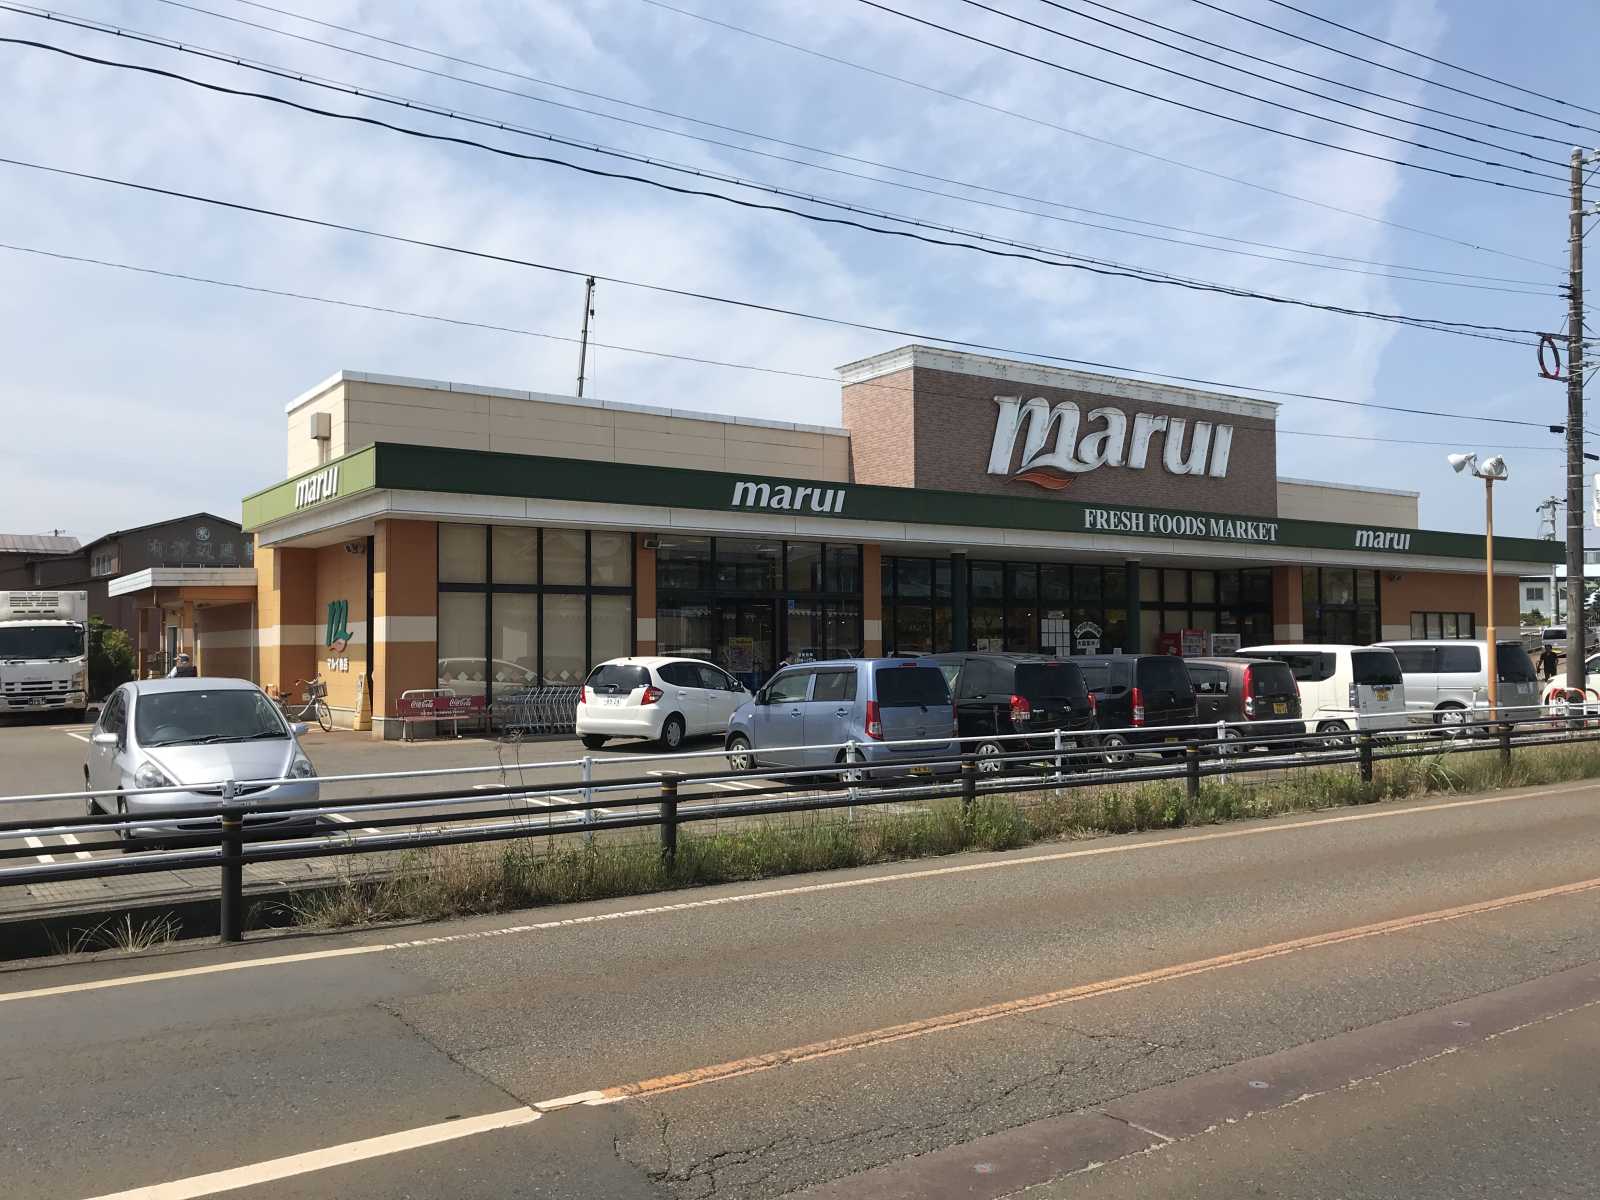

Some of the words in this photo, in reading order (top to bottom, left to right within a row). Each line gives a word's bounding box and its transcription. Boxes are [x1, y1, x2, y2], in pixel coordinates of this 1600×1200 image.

[987, 395, 1234, 478] marui
[295, 465, 338, 508] marui
[731, 481, 846, 513] marui
[1084, 508, 1145, 532] FRESH
[1149, 513, 1206, 537] FOODS
[1209, 518, 1278, 541] MARKET
[1355, 529, 1411, 550] marui
